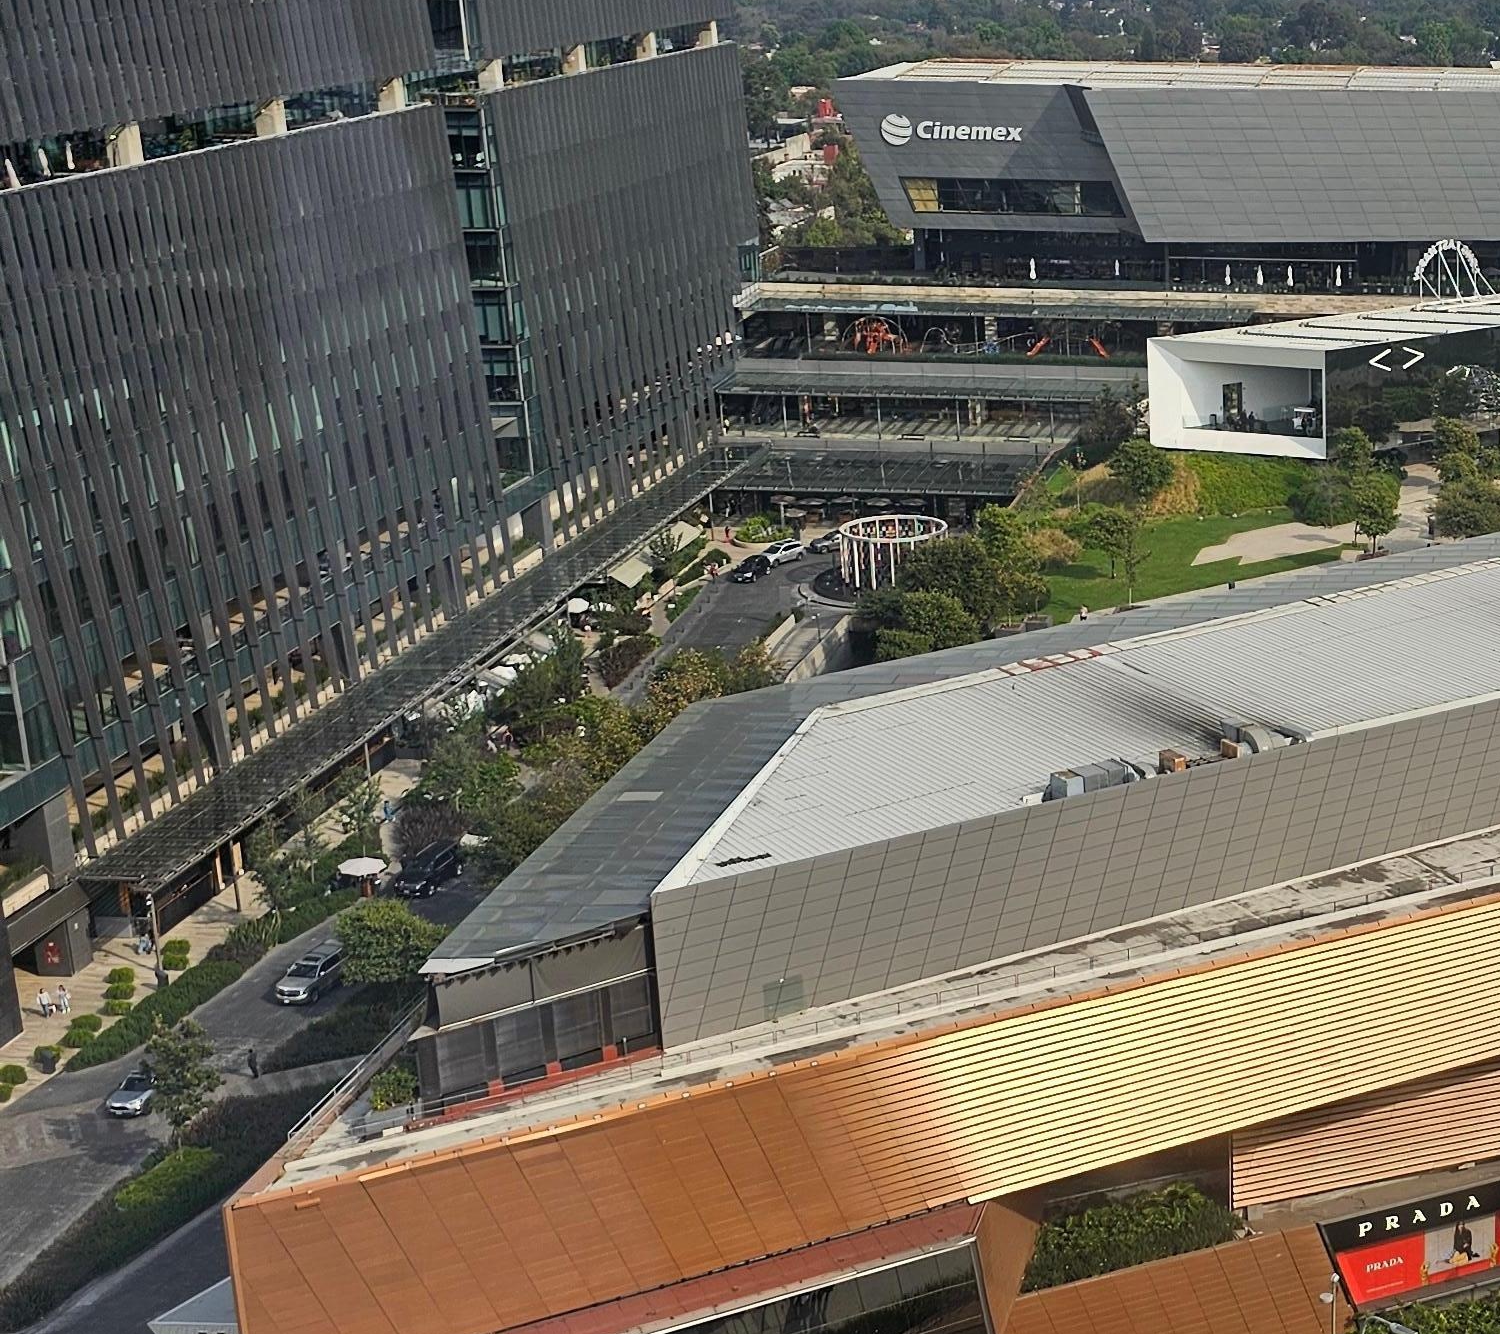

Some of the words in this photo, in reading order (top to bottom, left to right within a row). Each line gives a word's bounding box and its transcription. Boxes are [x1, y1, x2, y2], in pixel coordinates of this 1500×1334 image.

[916, 121, 1022, 141] Cinemex
[1358, 1195, 1480, 1237] PRADA
[1366, 1256, 1404, 1273] PRADA
